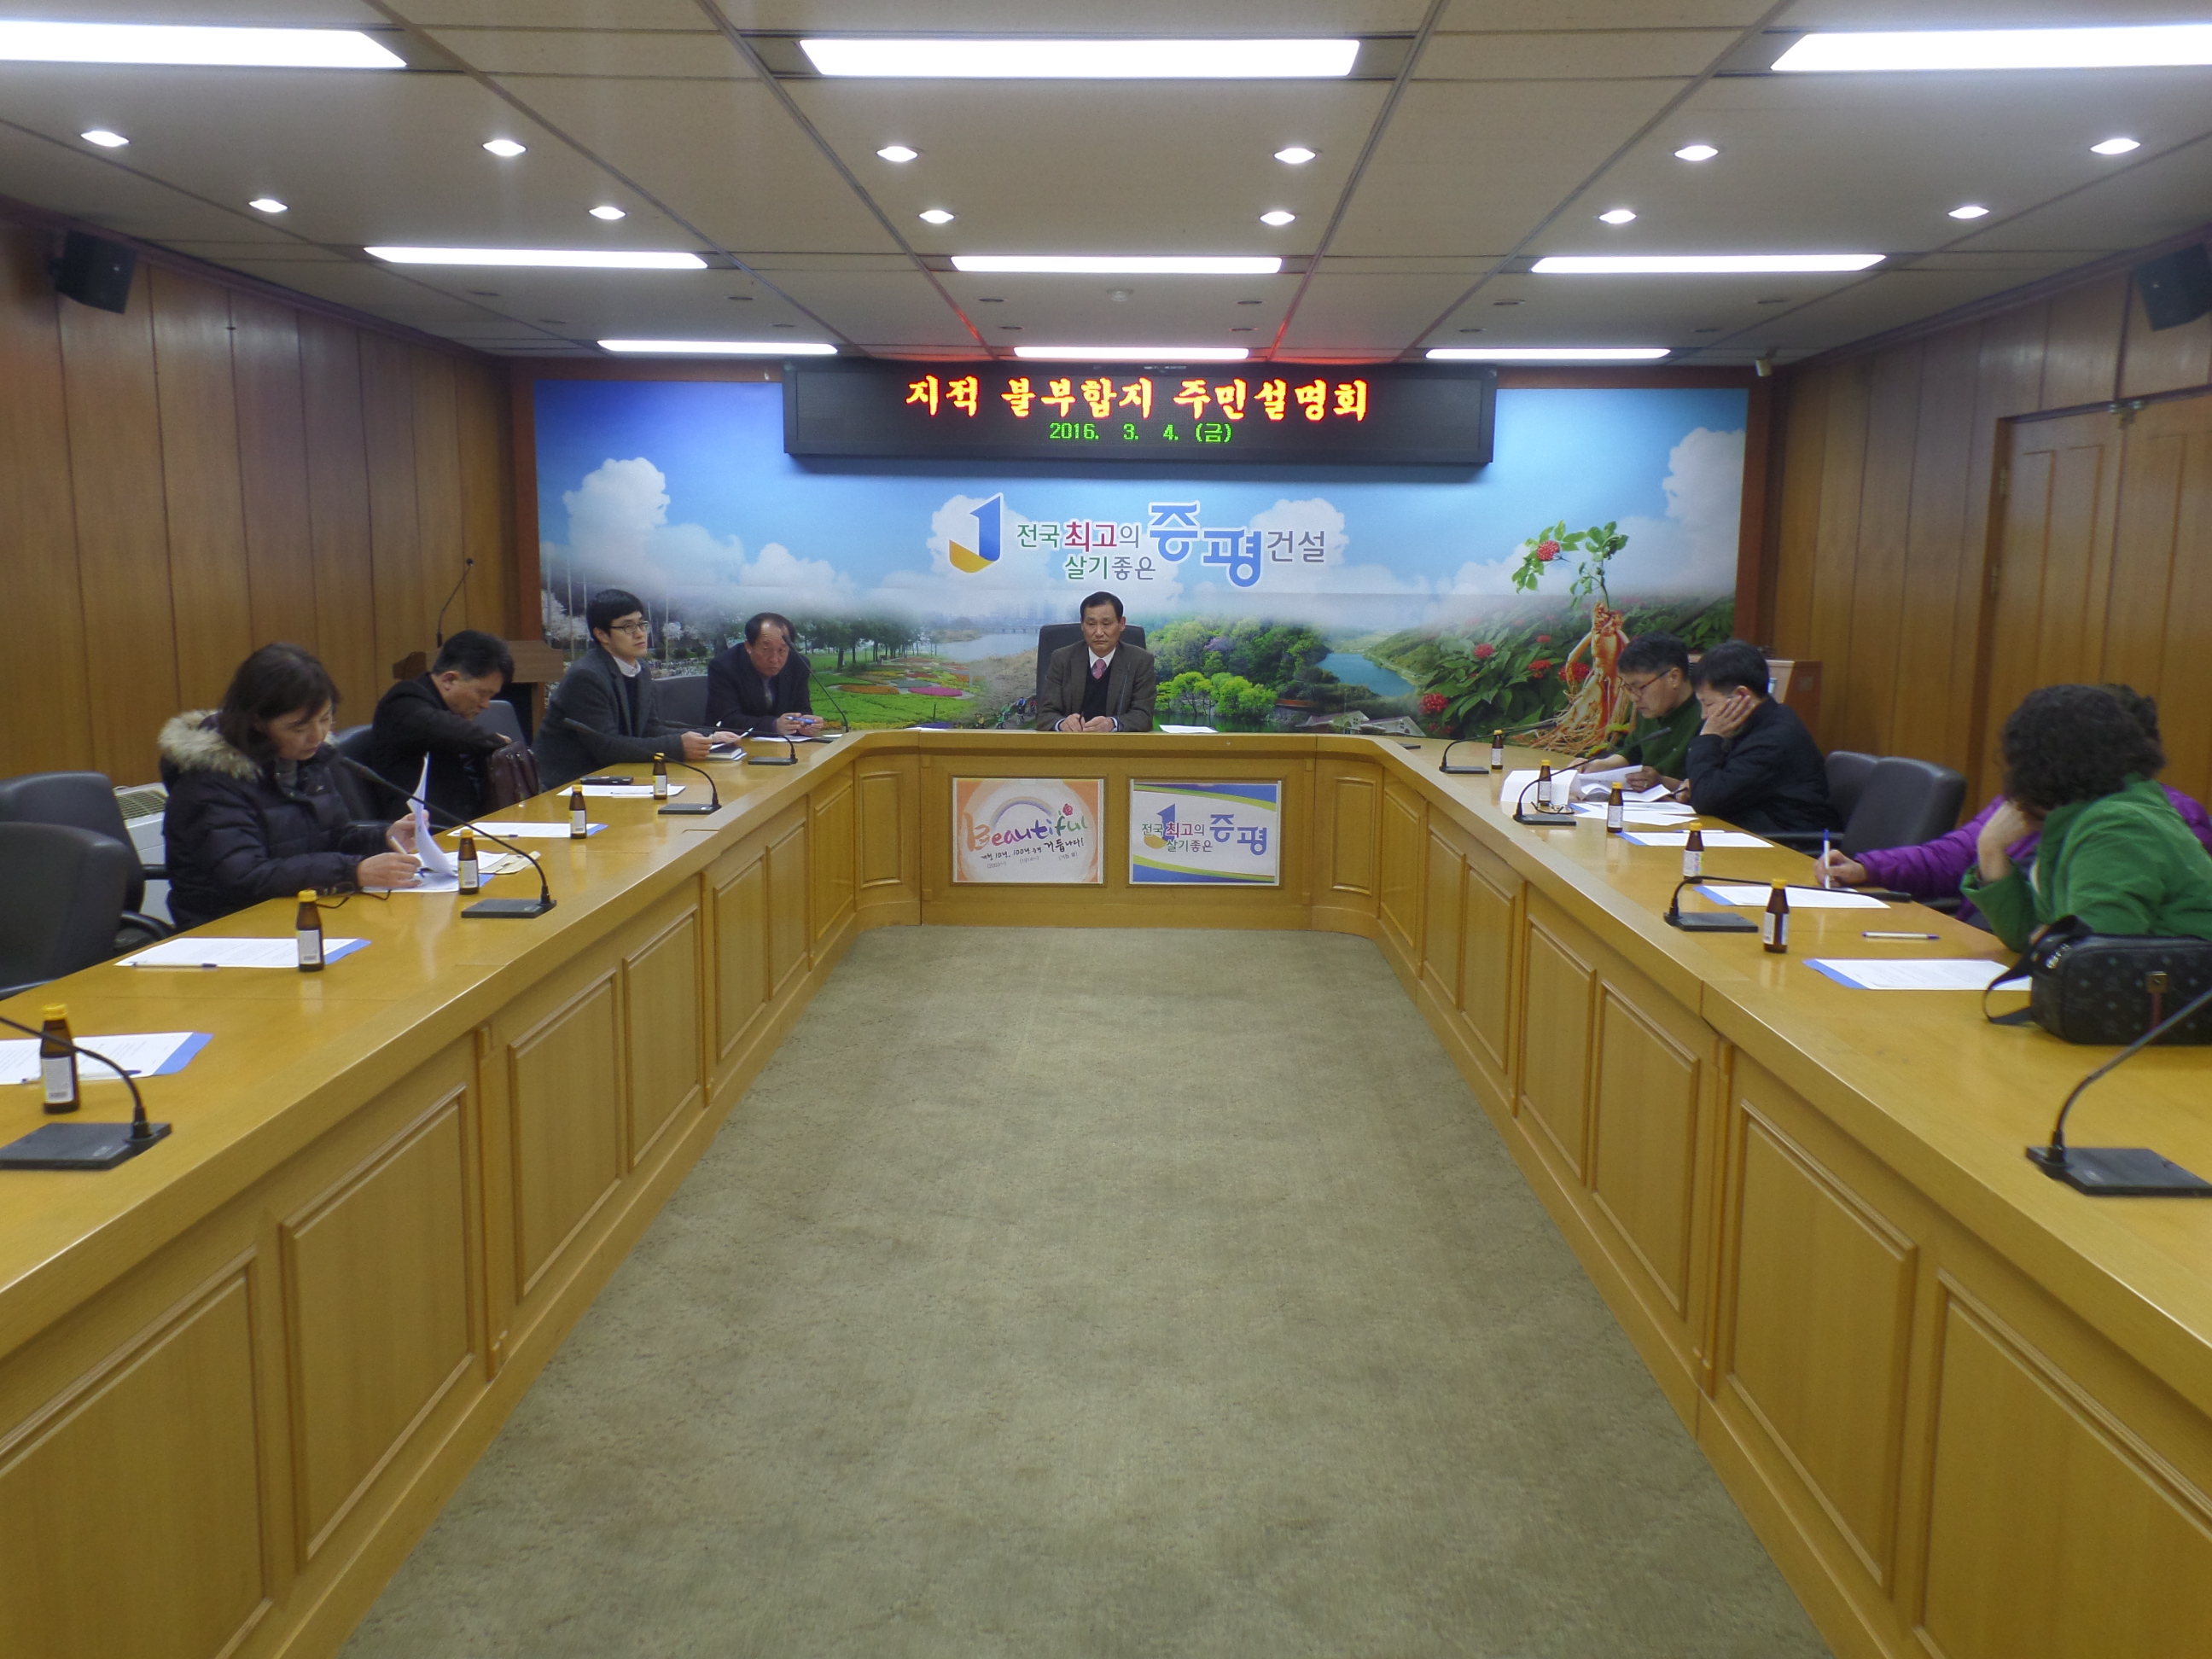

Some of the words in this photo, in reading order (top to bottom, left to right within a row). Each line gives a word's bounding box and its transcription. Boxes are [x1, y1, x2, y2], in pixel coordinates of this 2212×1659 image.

[905, 375, 979, 417] 지적
[1001, 377, 1152, 419] 불부합지
[1173, 378, 1367, 421] 주민설명회
[1049, 422, 1100, 440] 2016.
[1123, 423, 1139, 440] 3.
[1162, 424, 1179, 441] 4.
[1196, 422, 1232, 443] (금)
[1150, 504, 1262, 588] 증평
[1267, 530, 1325, 563] 건설
[963, 811, 1089, 852] Beautiful
[1209, 813, 1267, 856] 증평
